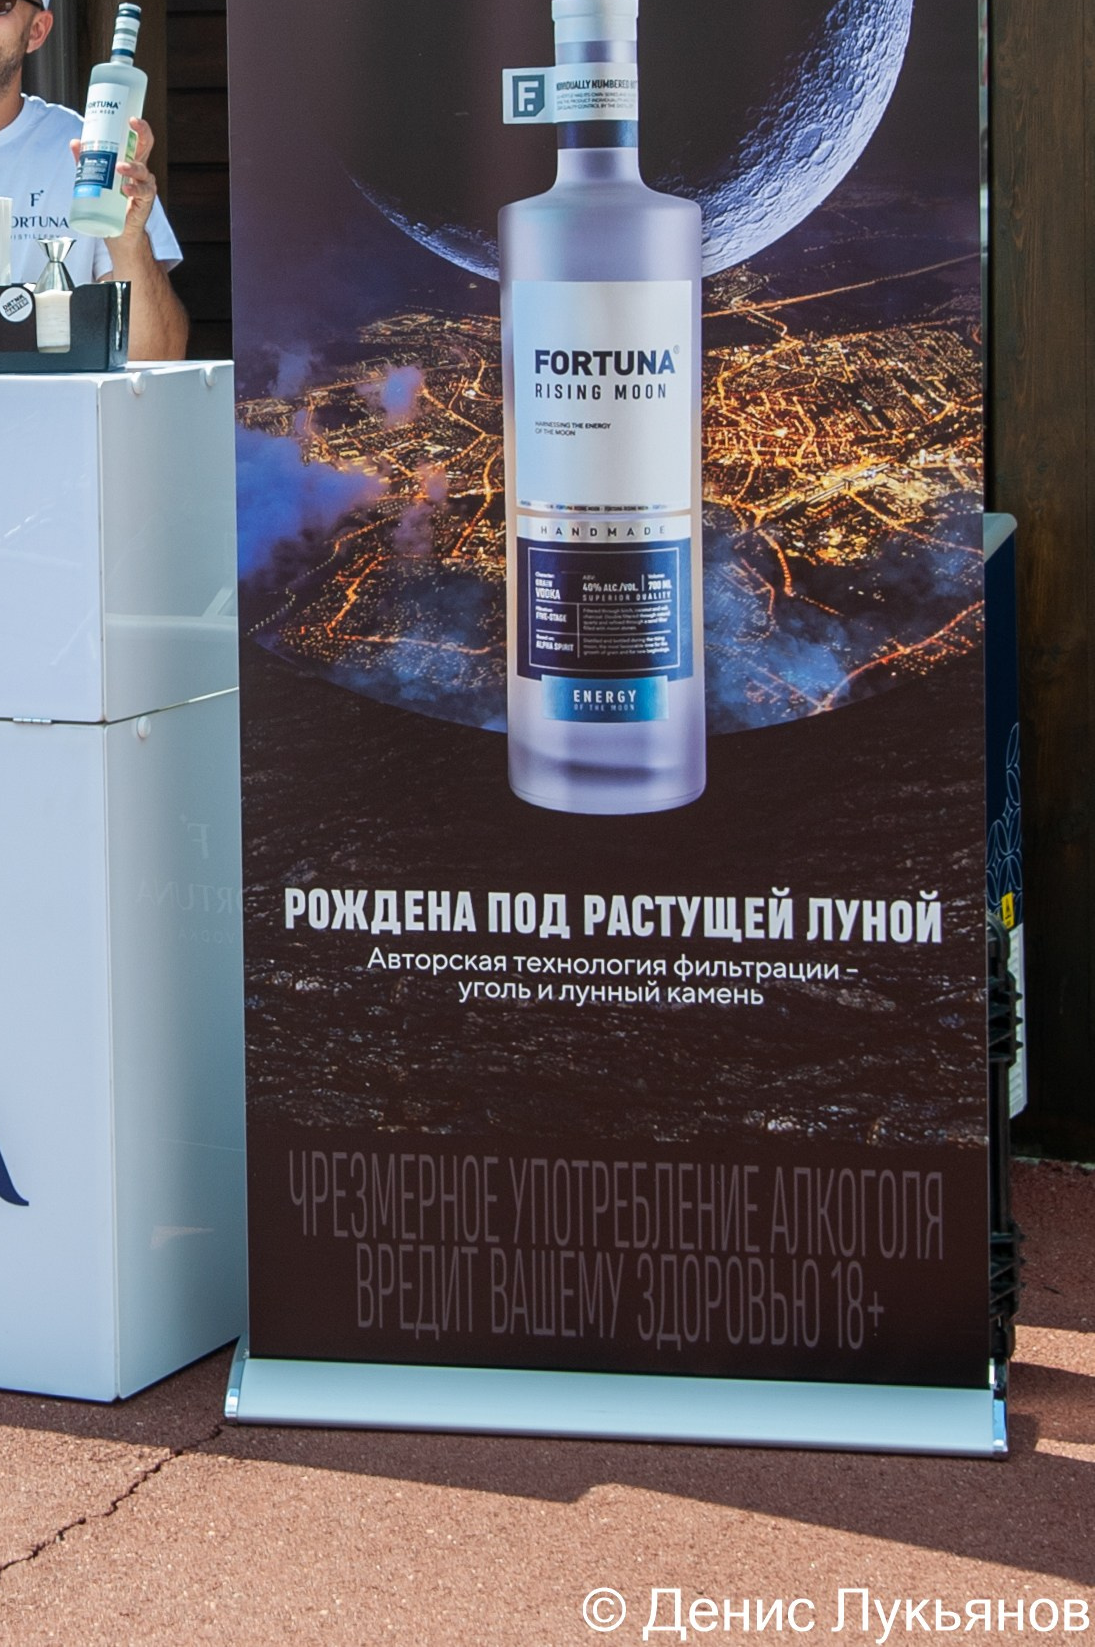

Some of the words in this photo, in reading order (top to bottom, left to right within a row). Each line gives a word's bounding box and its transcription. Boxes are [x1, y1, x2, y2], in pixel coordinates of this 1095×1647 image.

[11, 216, 70, 229] ORTUNA
[534, 349, 676, 376] FORTUNA
[535, 383, 601, 400] RISING
[614, 384, 666, 400] MOON
[540, 525, 665, 537] HANDMADE
[535, 588, 560, 600] VODKA
[582, 583, 602, 592] 40%
[636, 591, 671, 601] QUALITY
[574, 690, 636, 703] ENERGY
[284, 887, 476, 935] РОЖДЕНА
[487, 891, 571, 941] ПОД
[583, 886, 795, 945] РАСТУЩЕЙ
[807, 889, 943, 944] ЛУНОЙ
[366, 947, 508, 982] Авторская
[512, 956, 667, 980] технология
[672, 952, 839, 984] фильтрации
[457, 980, 530, 1003] уголь
[537, 984, 554, 1000] и
[559, 976, 661, 1002] лунный
[667, 986, 764, 1005] камень
[288, 1150, 500, 1243] ЧРЕЗМЕРНОЕ
[508, 1157, 761, 1255] УПОТРЕБЛЕНИЕ
[770, 1165, 944, 1261] АЛКОГОЛЯ
[355, 1242, 479, 1340] ВРЕДИТ
[490, 1248, 625, 1338] ВАШЕМУ
[636, 1253, 822, 1351] ЗДОРОВЬЮ
[828, 1261, 885, 1351] 18+
